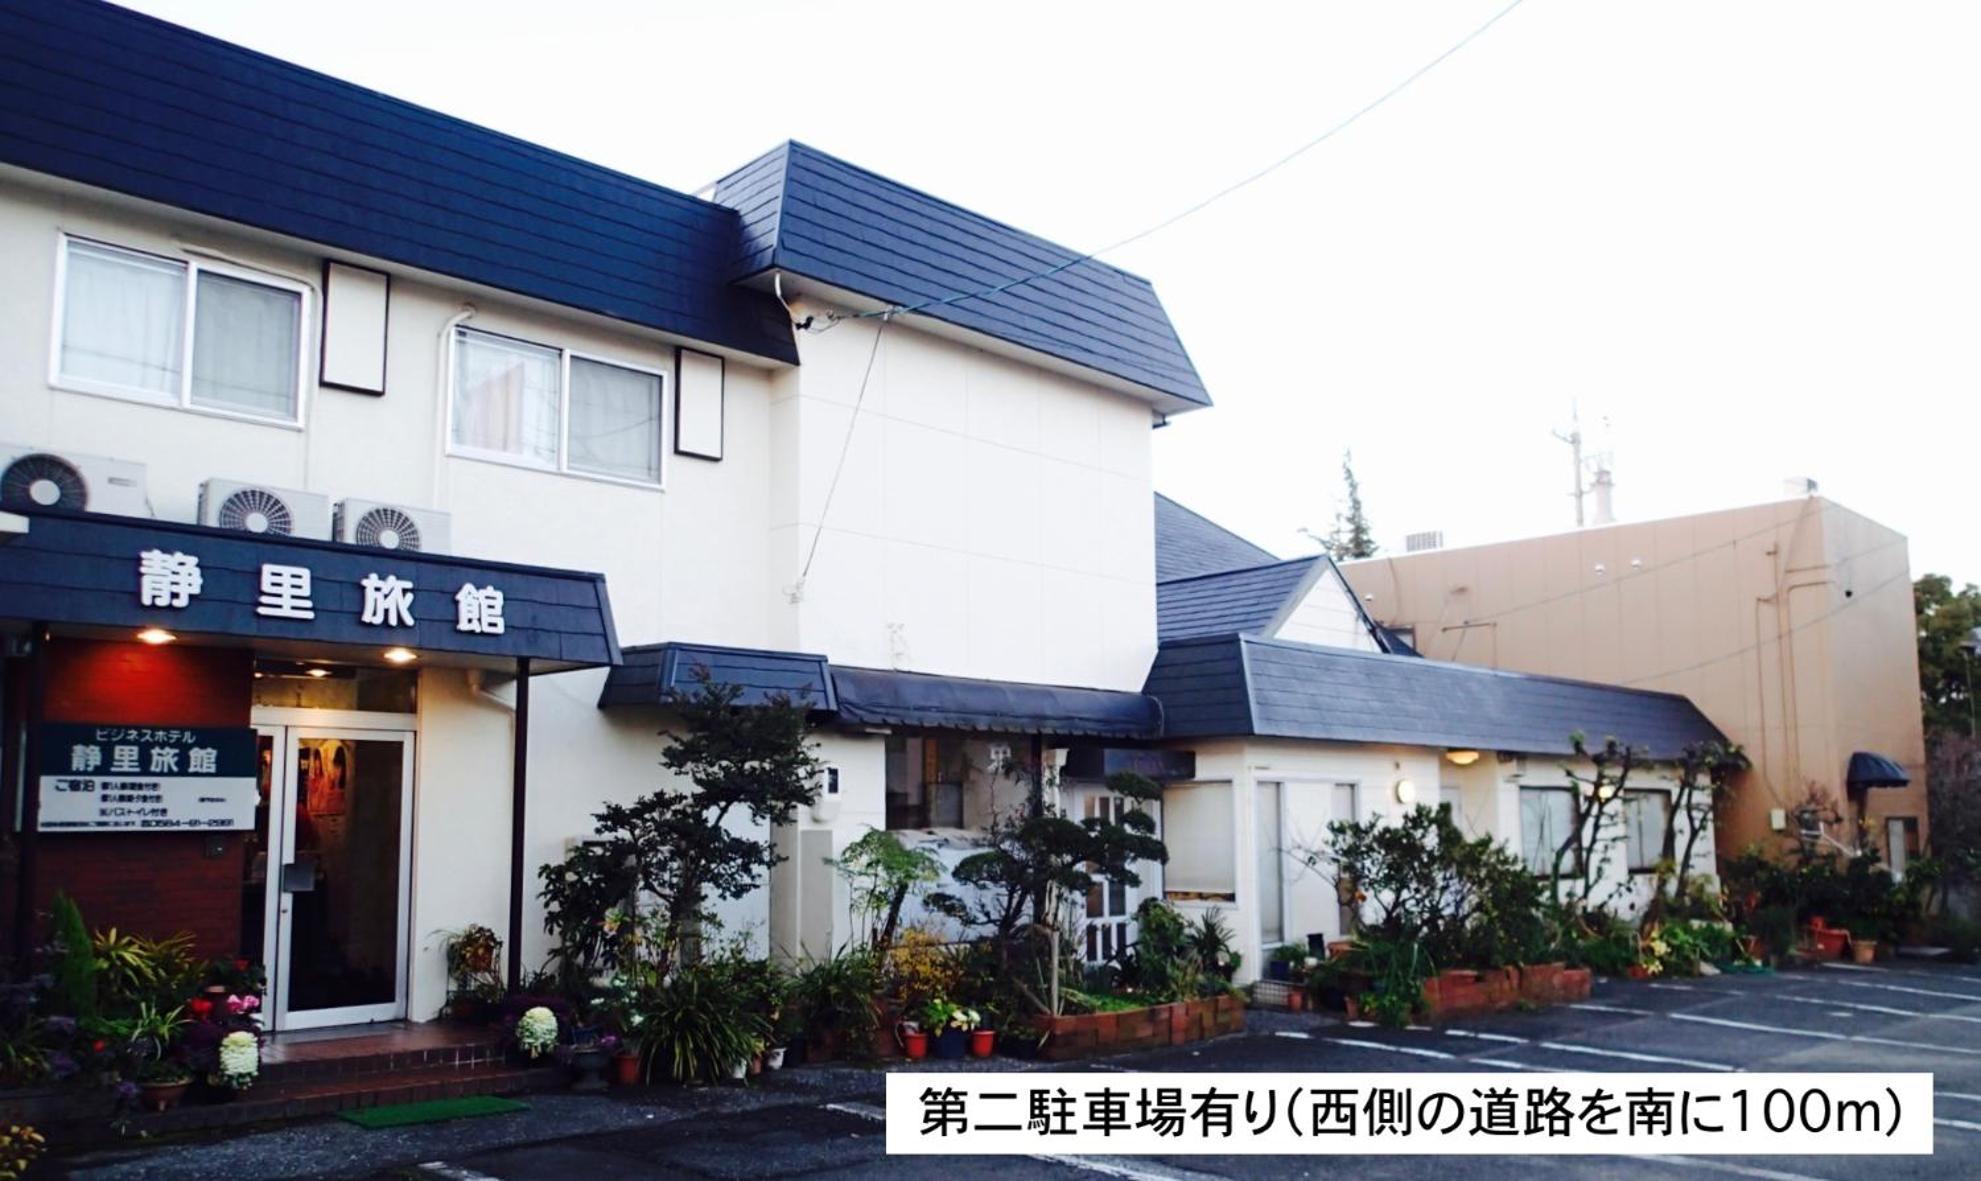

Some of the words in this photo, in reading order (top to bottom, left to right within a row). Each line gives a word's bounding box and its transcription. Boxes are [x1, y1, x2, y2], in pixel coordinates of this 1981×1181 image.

[138, 549, 505, 634] 静里旅館
[96, 729, 196, 744] ビジネスホテル
[71, 744, 218, 773] 静里旅館
